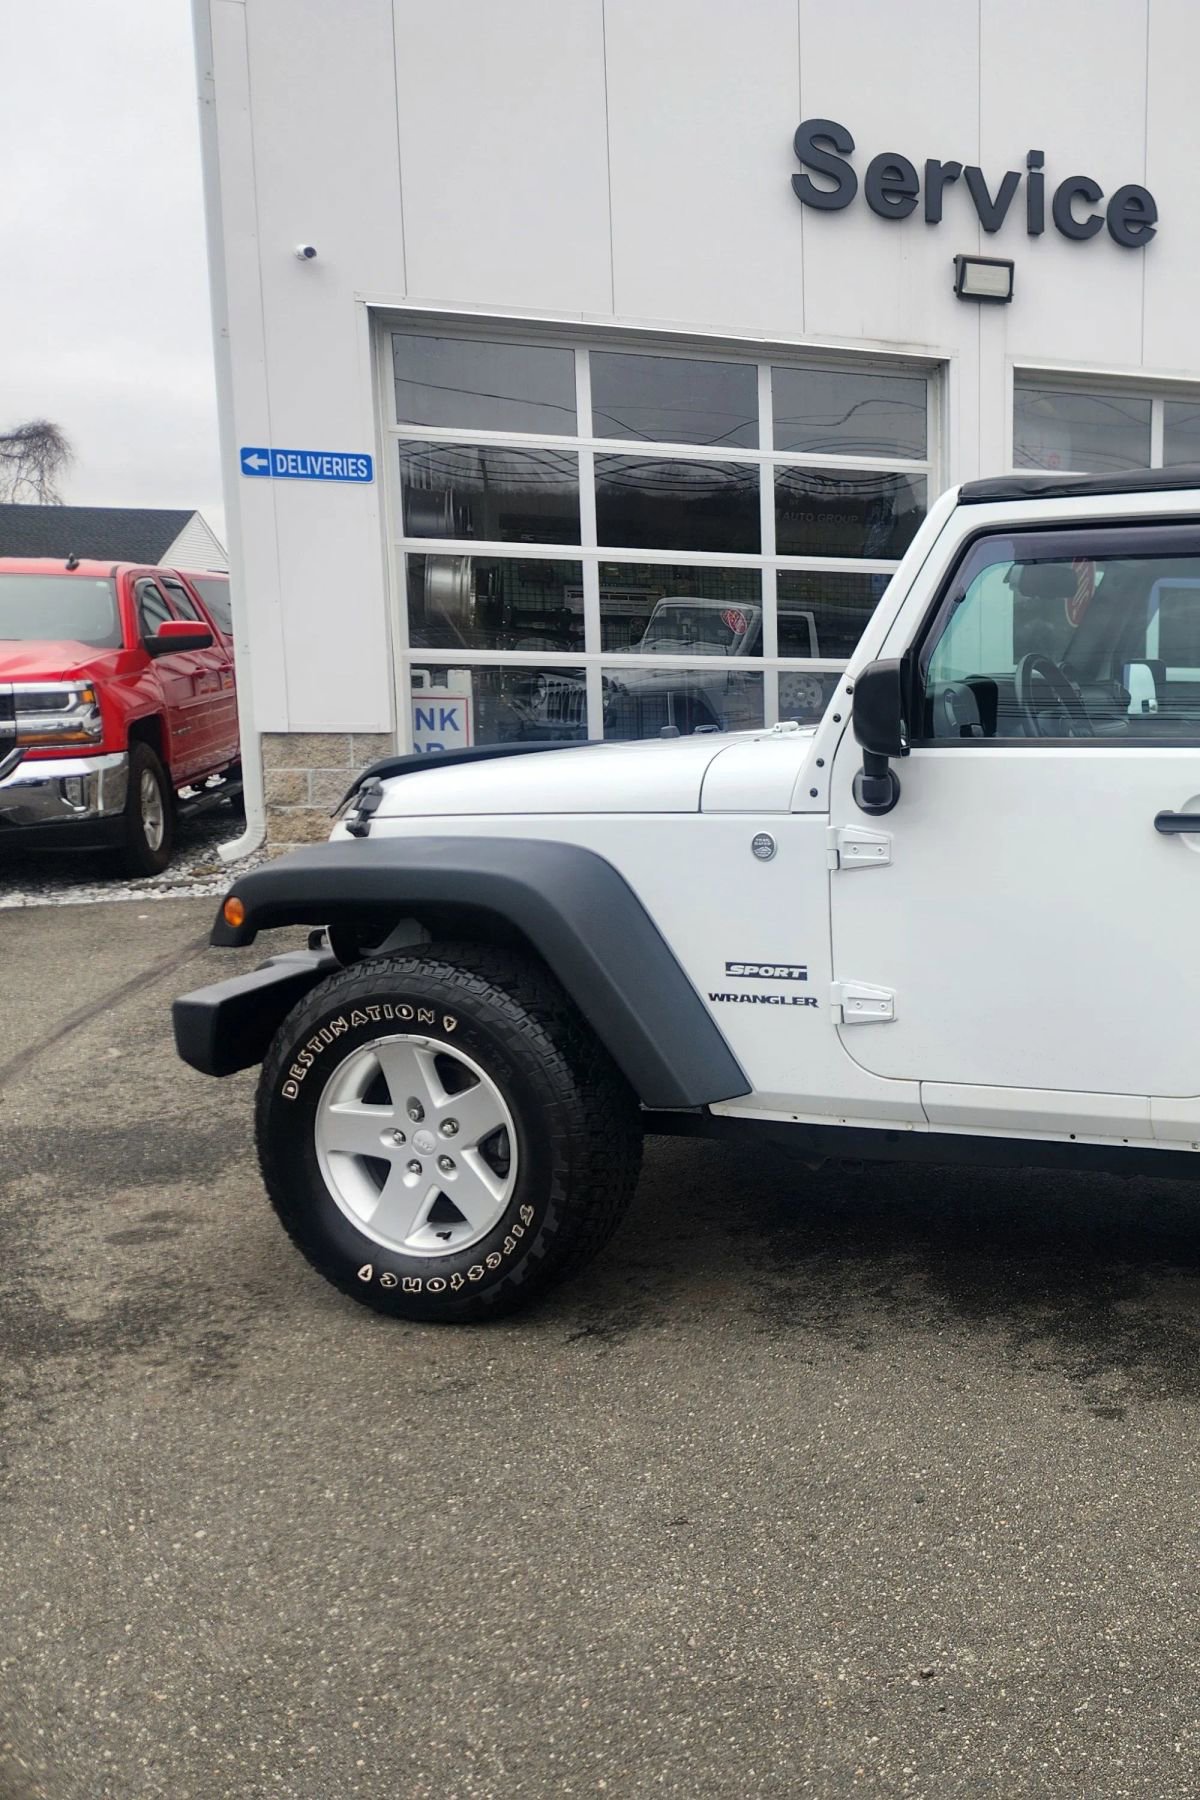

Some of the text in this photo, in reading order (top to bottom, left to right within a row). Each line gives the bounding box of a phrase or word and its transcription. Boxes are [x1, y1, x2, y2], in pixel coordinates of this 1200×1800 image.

[791, 118, 1158, 248] Service
[276, 453, 368, 478] DELIVERIES
[783, 511, 815, 522] AUTO
[817, 513, 858, 524] GROUP
[728, 964, 806, 978] SPORT
[708, 992, 819, 1008] WRANGLER
[282, 1004, 435, 1099] DESTINATION
[380, 1203, 535, 1292] Firestone
